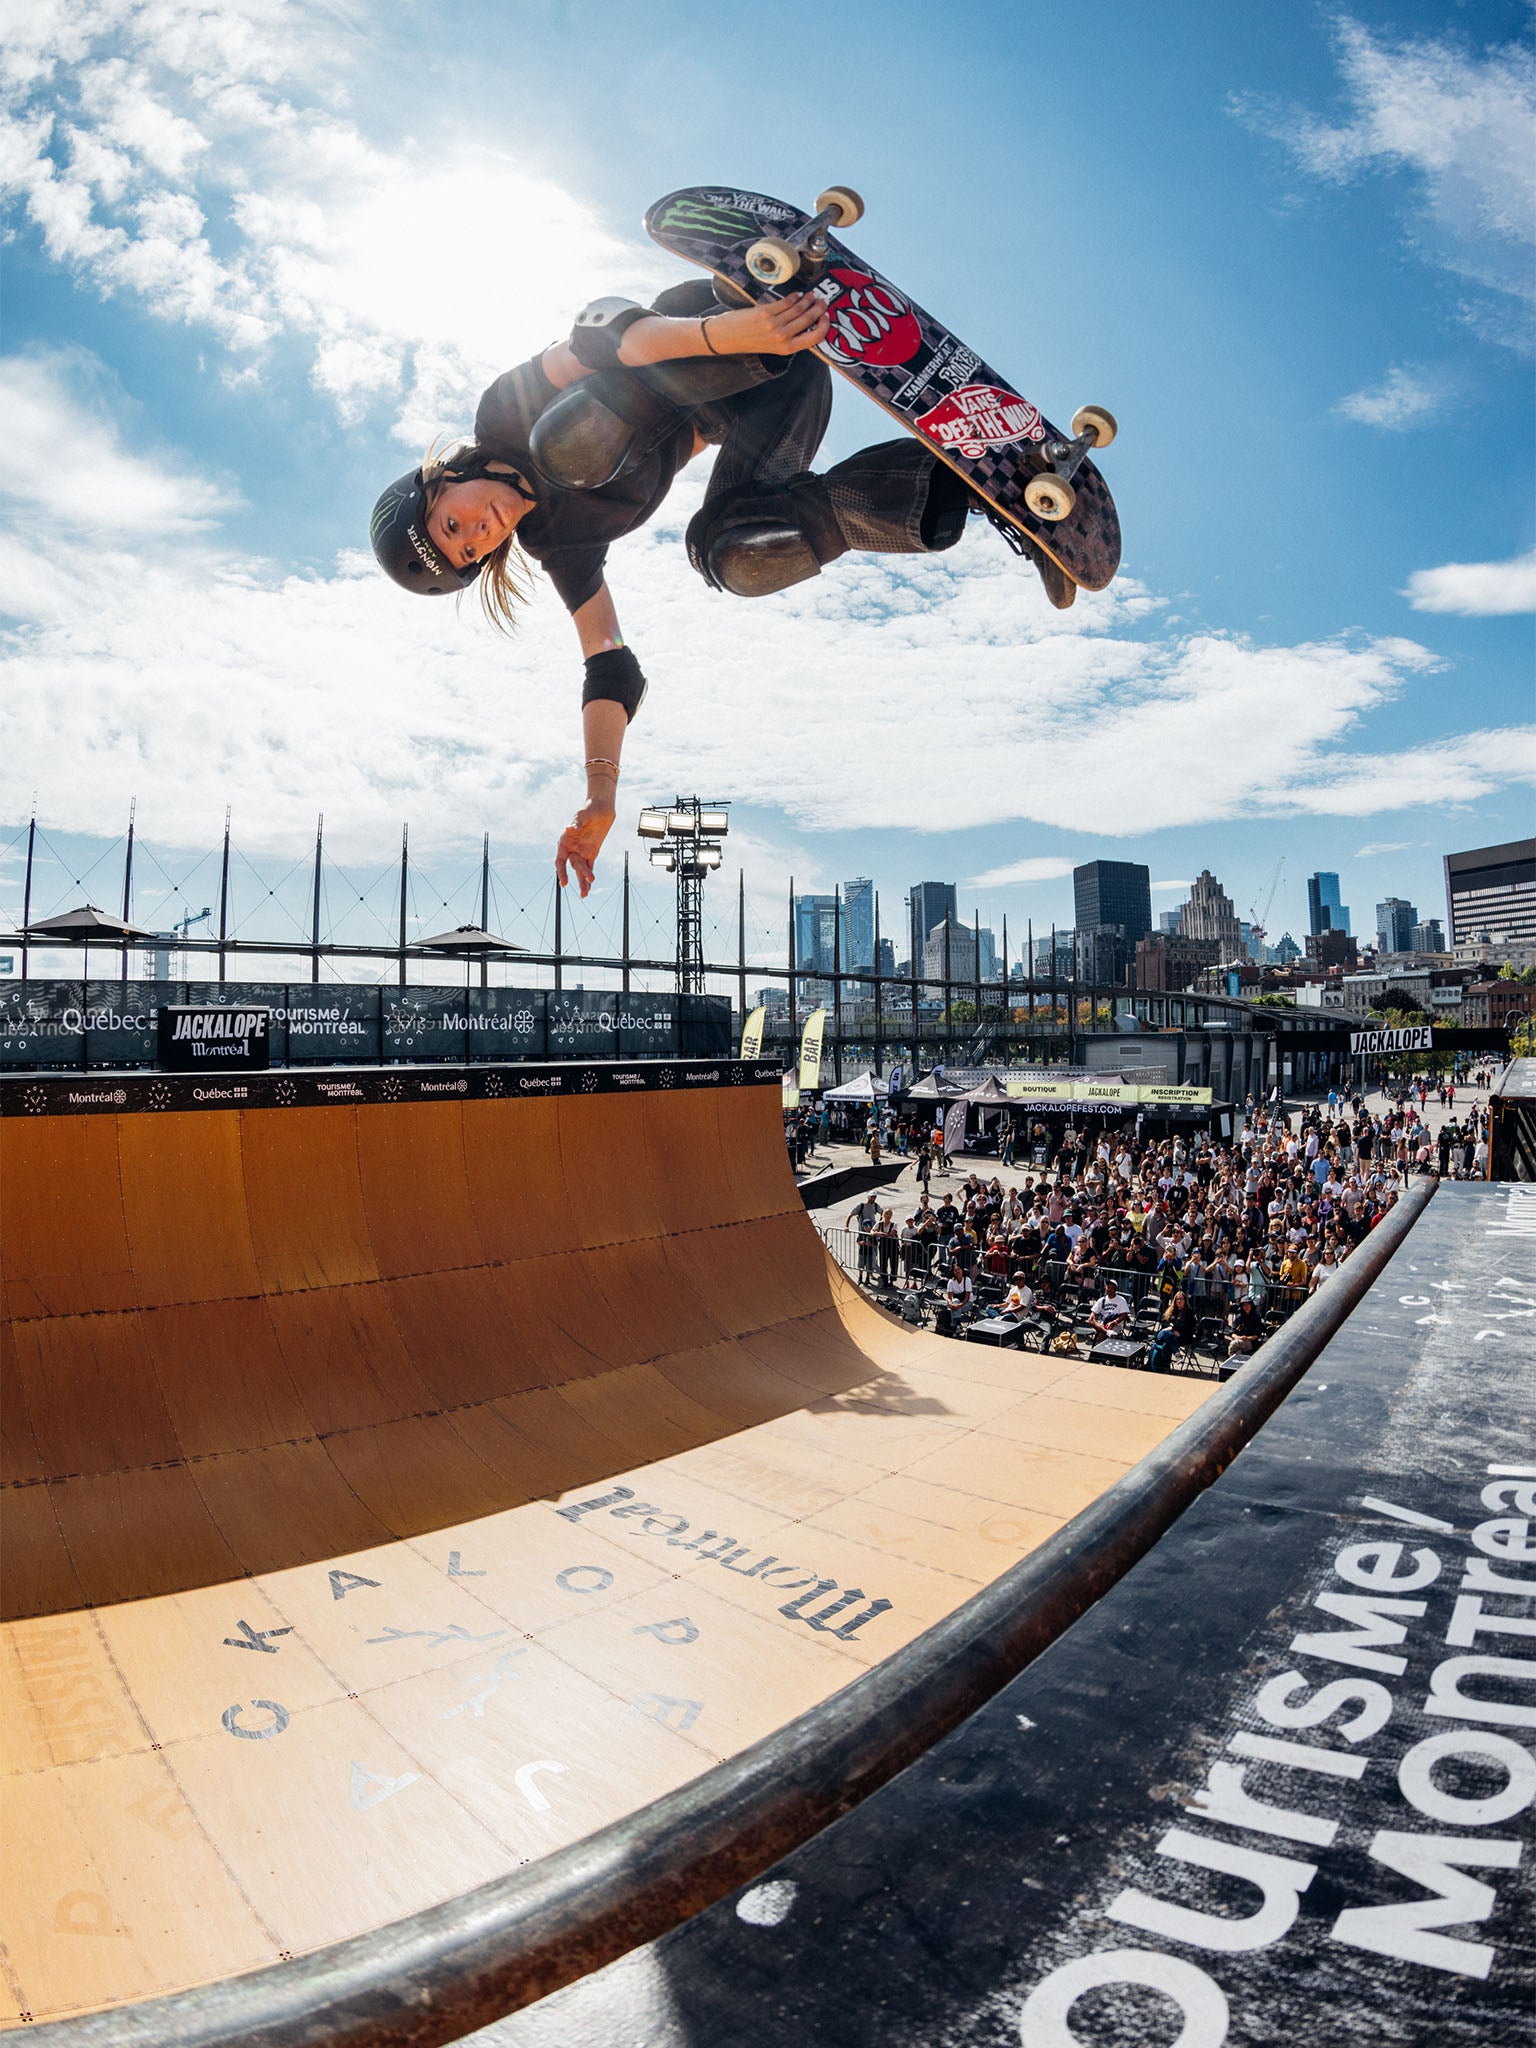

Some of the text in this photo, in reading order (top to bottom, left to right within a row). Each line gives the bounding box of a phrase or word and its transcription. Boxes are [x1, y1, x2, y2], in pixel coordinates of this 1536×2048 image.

[950, 388, 1000, 415] VANS
[966, 408, 1010, 438] THE
[62, 1008, 148, 1035] Québec
[172, 1013, 268, 1041] JACKALOPE
[442, 1012, 513, 1031] Montréal
[599, 1012, 653, 1033] Québec
[191, 1039, 250, 1057] Montréal
[1352, 1027, 1429, 1054] JACKALOPE
[803, 1037, 820, 1064] BAR
[519, 1077, 551, 1089] Québec
[685, 1071, 712, 1081] Montréal
[754, 1069, 776, 1079] Québec
[193, 1087, 233, 1101] Québec
[420, 1081, 457, 1092] Montréal
[1087, 1087, 1121, 1098] JACKALOPE
[1151, 1089, 1199, 1097] INSCRIPTION
[69, 1091, 113, 1104] Montréal
[1024, 1103, 1122, 1114] JACKALOPEFEST.COM
[556, 1485, 893, 1642] Montréal
